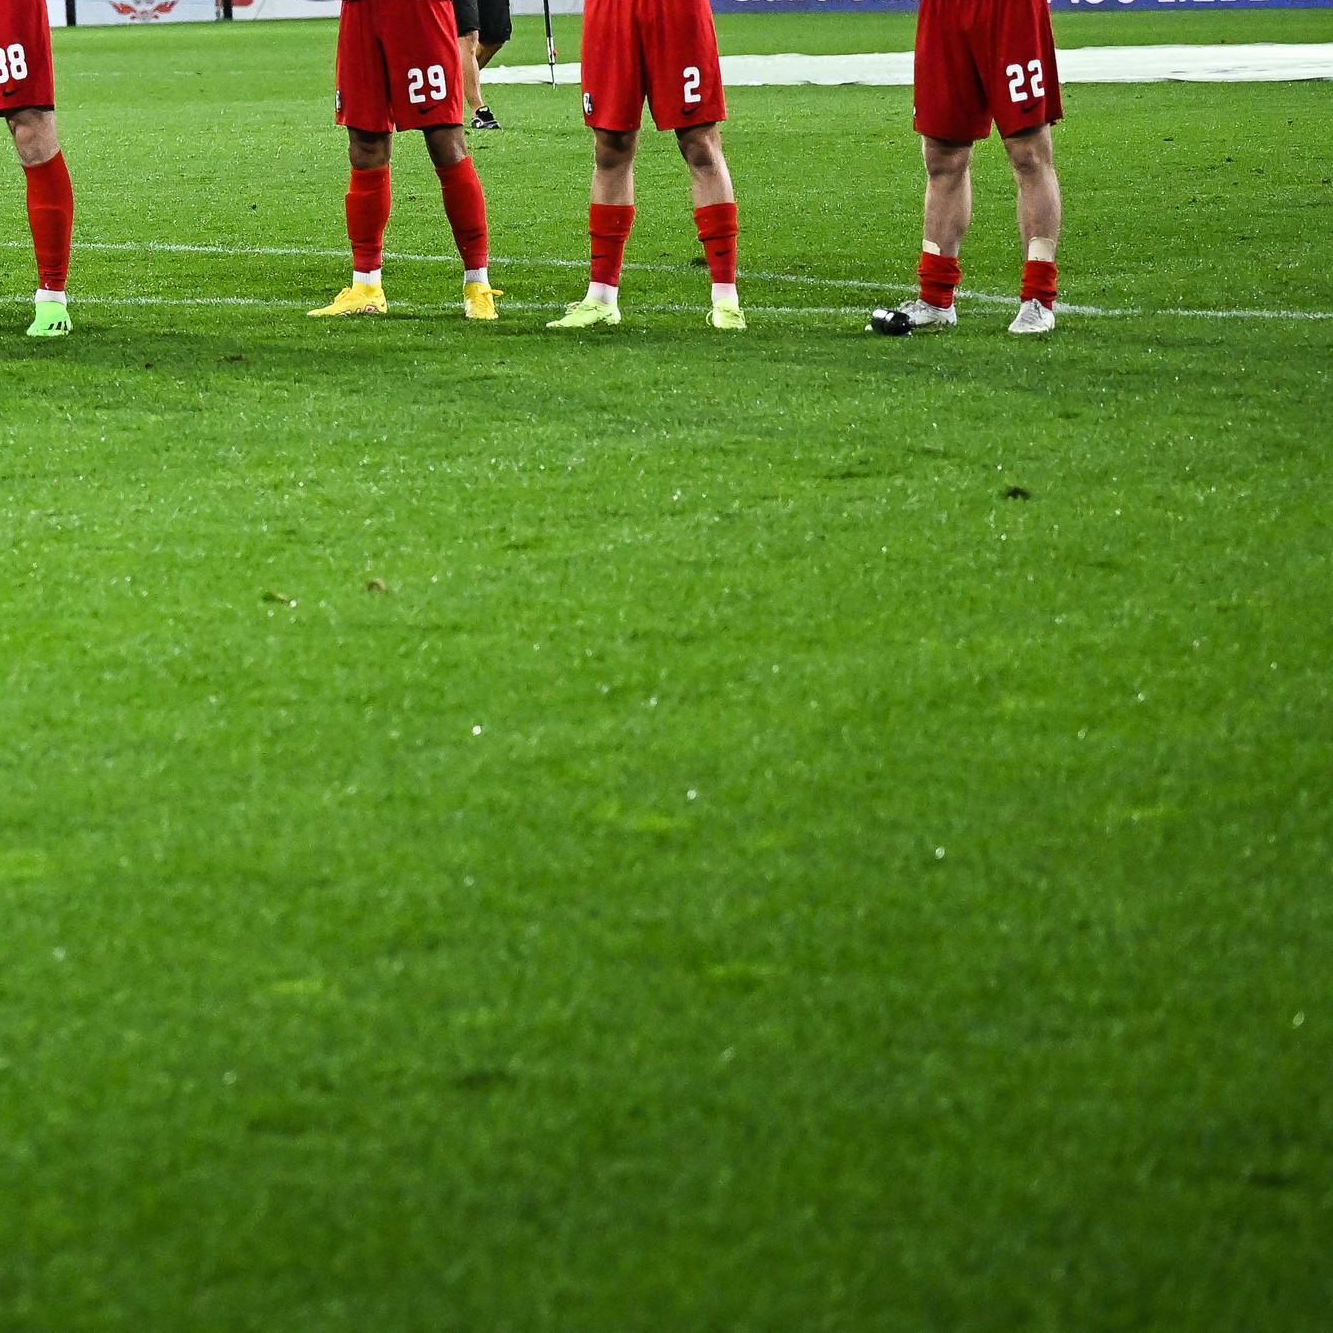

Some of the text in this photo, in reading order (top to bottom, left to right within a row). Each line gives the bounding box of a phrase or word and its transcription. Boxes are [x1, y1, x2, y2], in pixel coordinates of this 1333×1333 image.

[407, 64, 447, 103] 29
[683, 66, 701, 103] 2
[1006, 59, 1045, 102] 22
